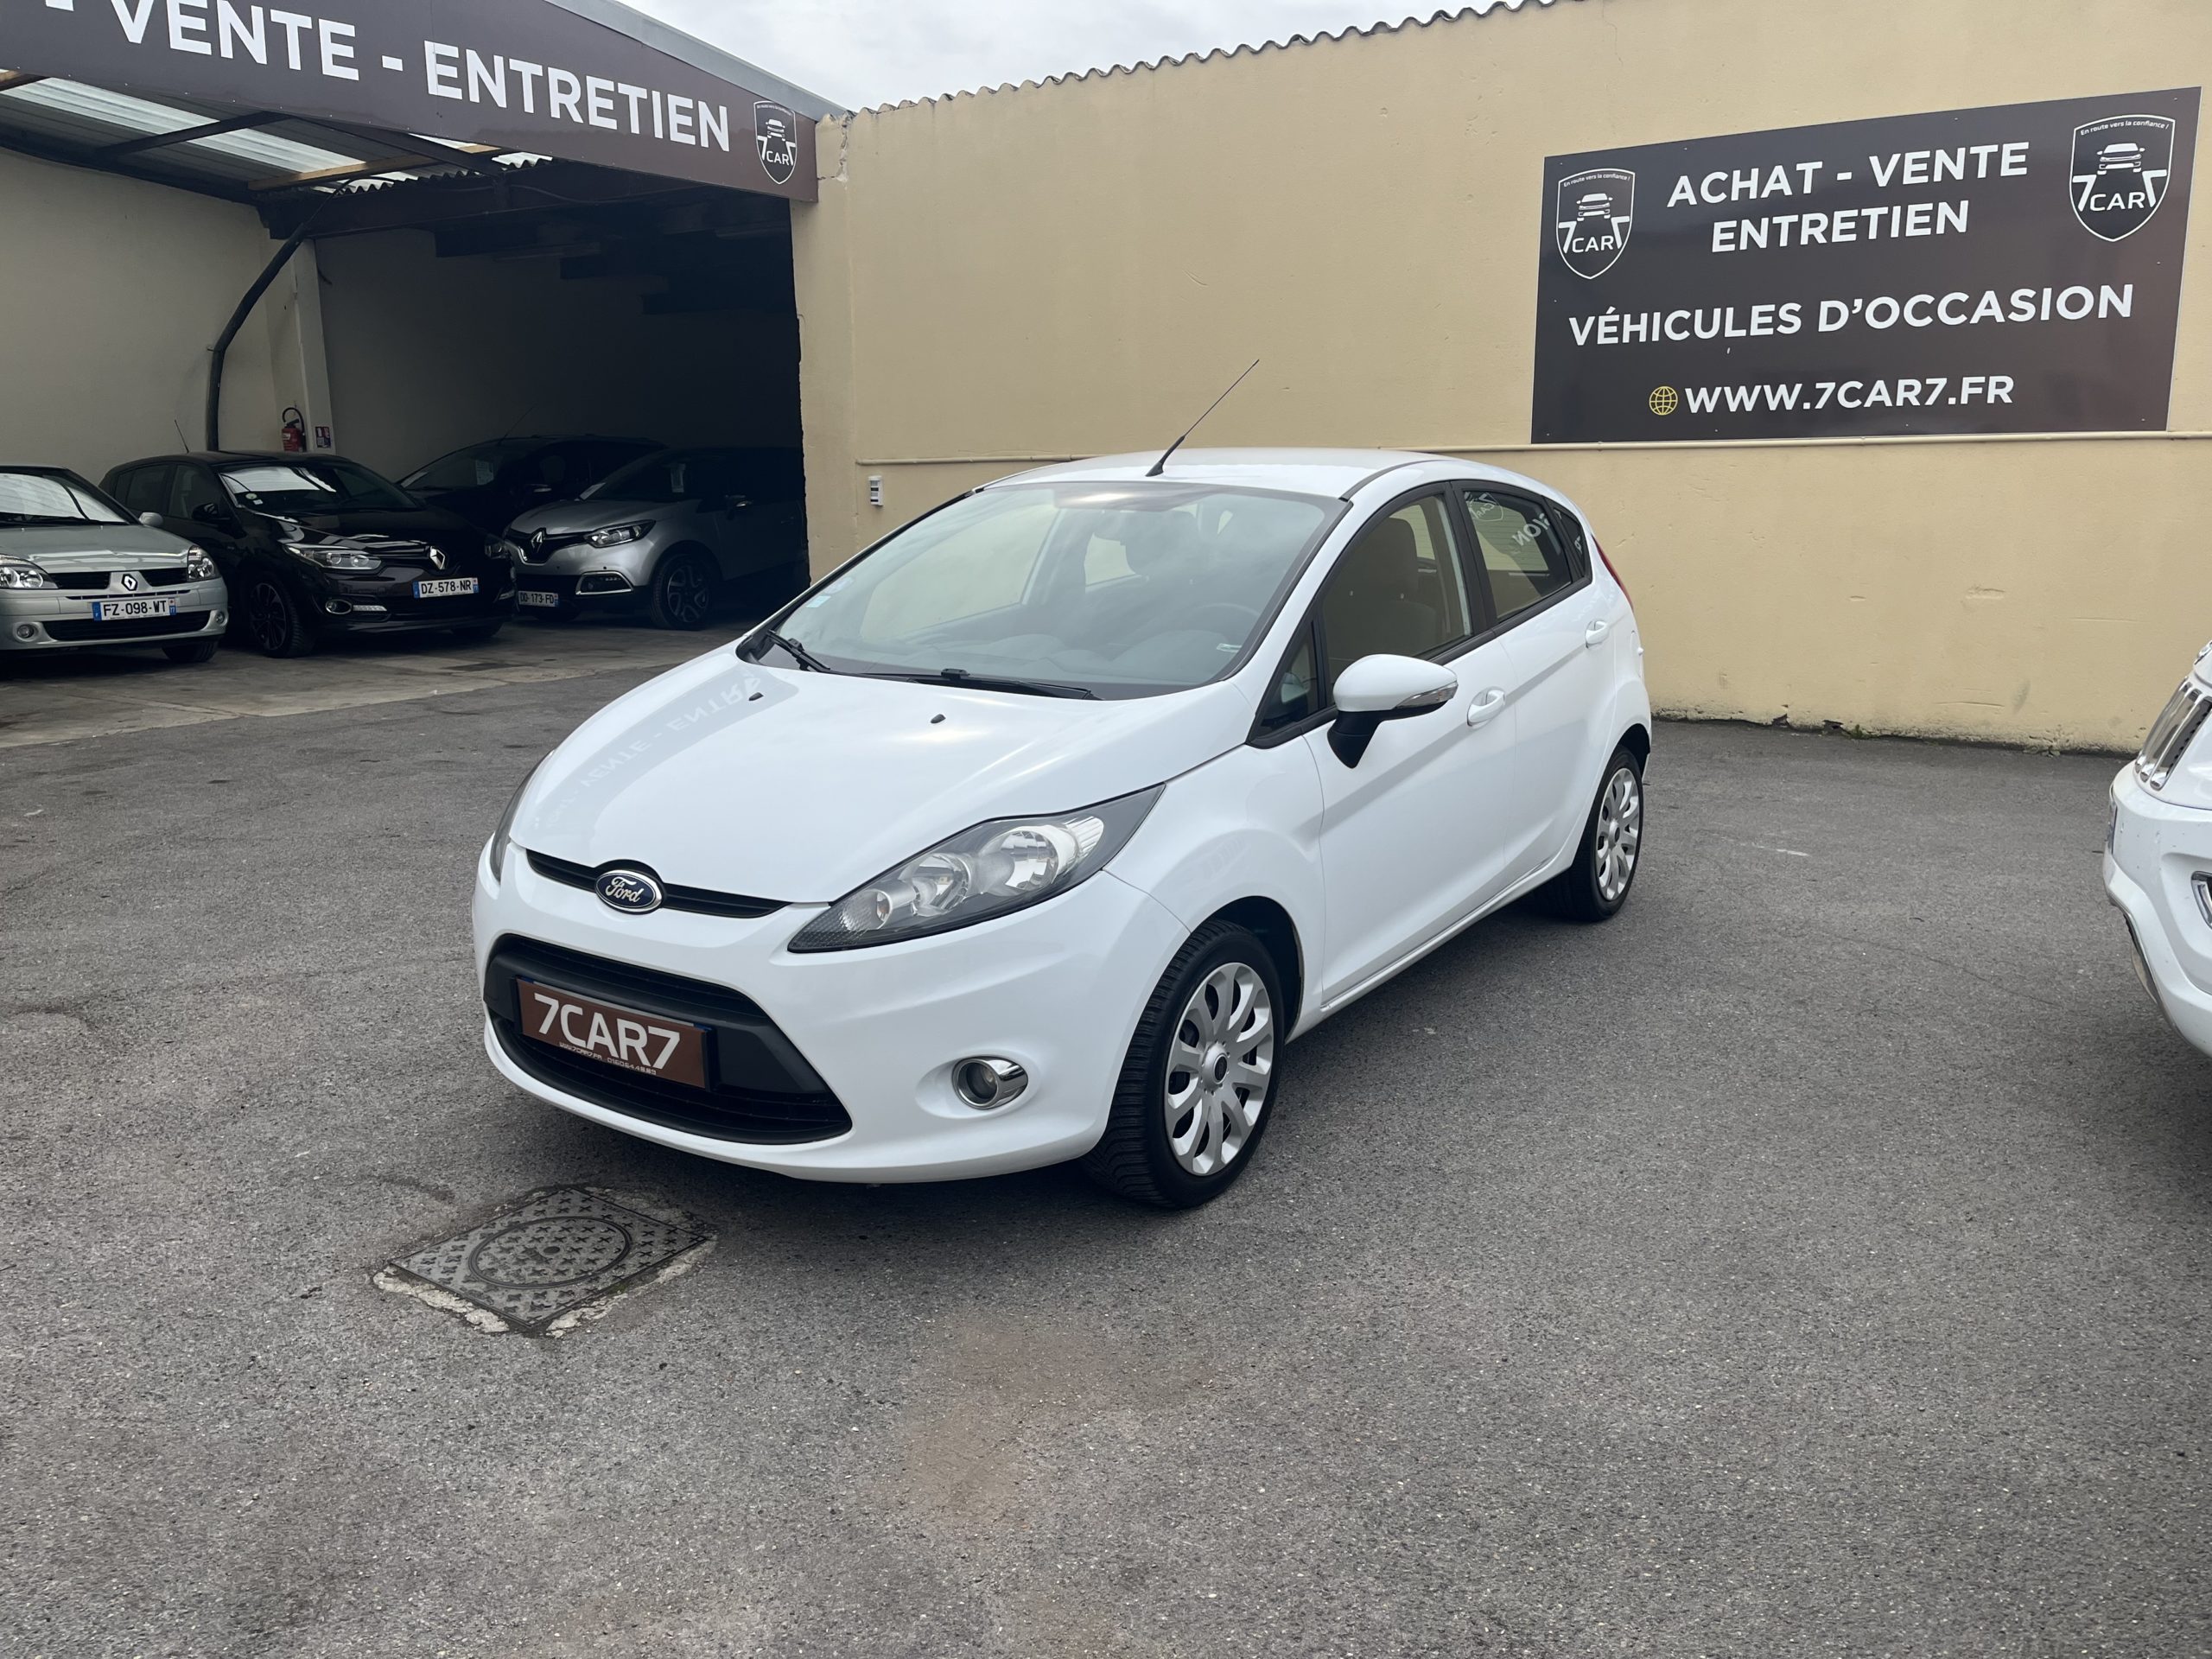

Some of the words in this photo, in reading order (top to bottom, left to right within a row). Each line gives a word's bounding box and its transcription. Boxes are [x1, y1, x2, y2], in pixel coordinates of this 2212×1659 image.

[111, 0, 359, 81] VENTE
[424, 41, 730, 152] ENTRETIEN
[2090, 124, 2108, 133] route
[2133, 120, 2164, 129] confiance
[1668, 162, 1823, 208] ACHAT
[1868, 141, 2031, 188] VENTE
[1712, 200, 1970, 253] ENTRETIEN
[1568, 303, 1802, 346] VÉHICULES
[1684, 376, 2014, 414] WWW.7CAR7.FR
[421, 580, 472, 594] DZ-578-NR
[104, 600, 167, 616] FZ-098-WT
[605, 876, 645, 903] Ford
[533, 993, 680, 1070] 7CAR7
